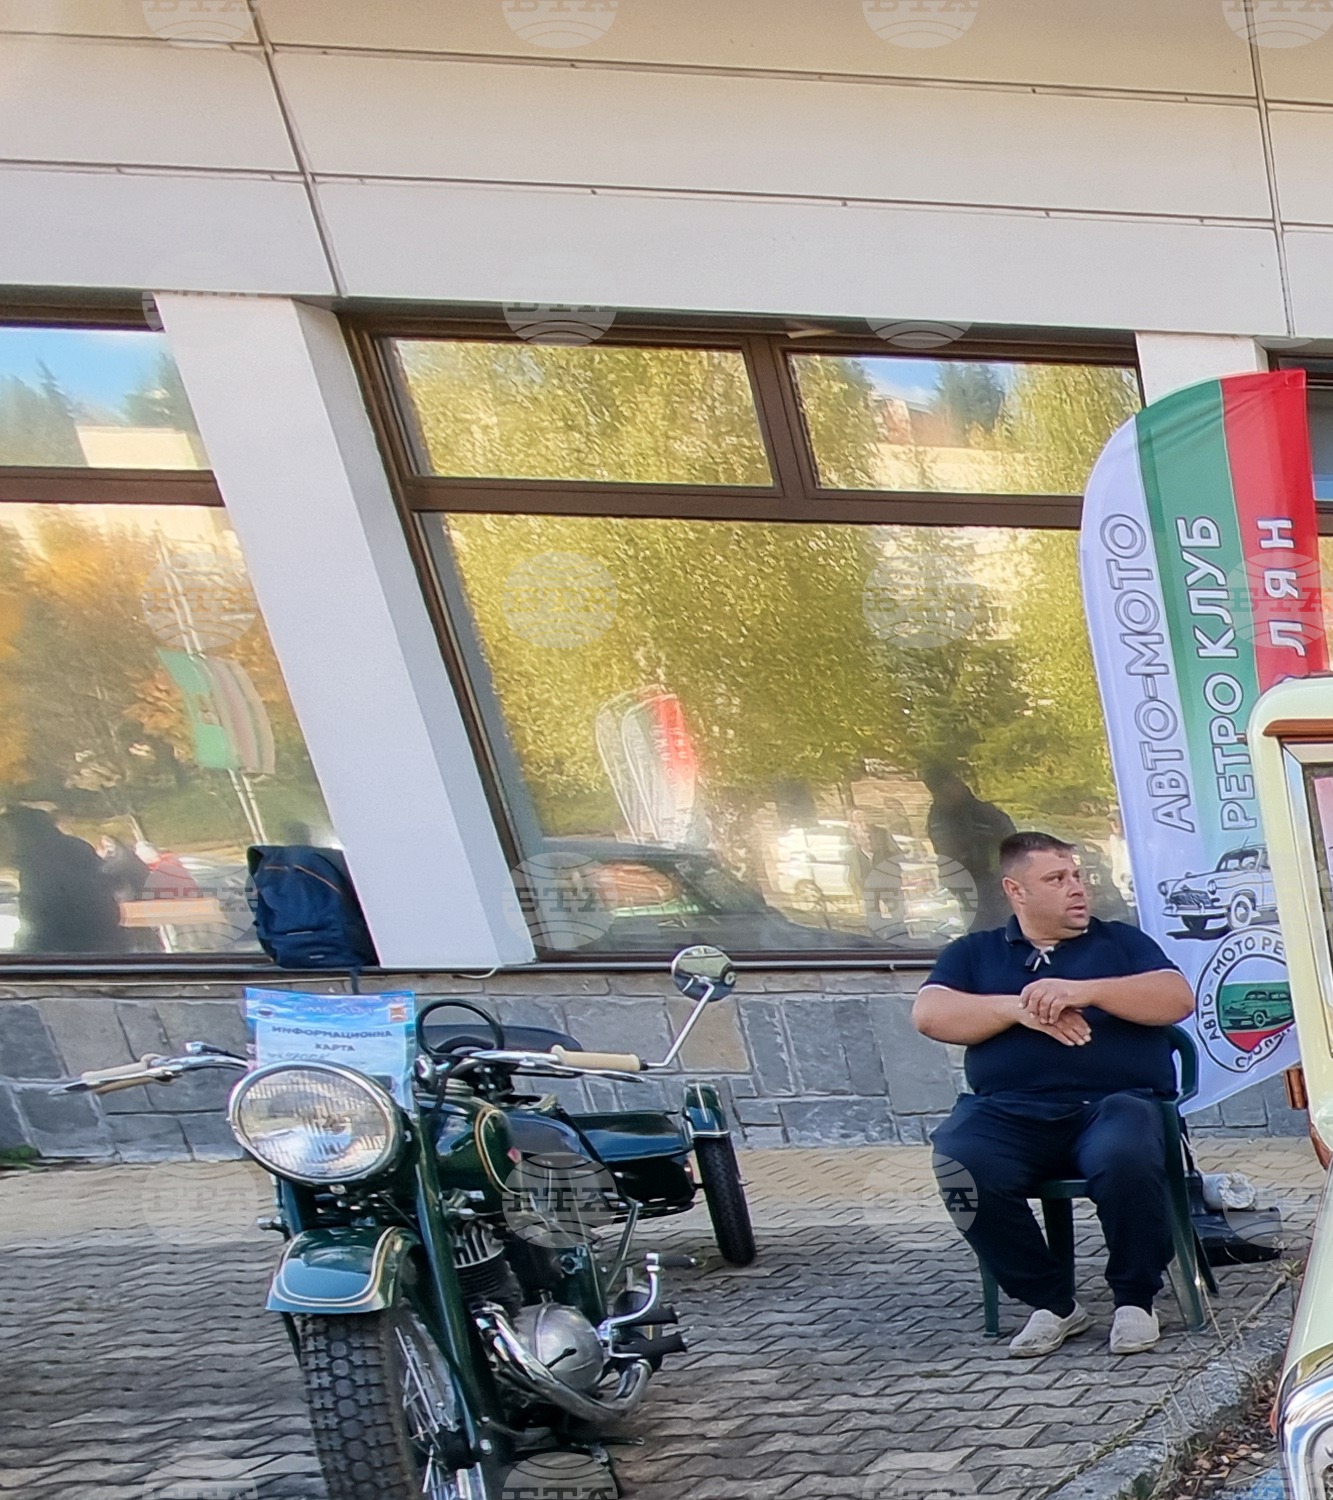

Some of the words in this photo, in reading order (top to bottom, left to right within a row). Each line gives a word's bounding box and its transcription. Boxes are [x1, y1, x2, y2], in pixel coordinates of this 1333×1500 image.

[1176, 516, 1239, 658] КЛУБ
[1100, 513, 1196, 833] АВТО-МОТО
[1203, 672, 1257, 831] РЕТРО
[271, 1026, 393, 1040] ИНФОРМАЦИОННА
